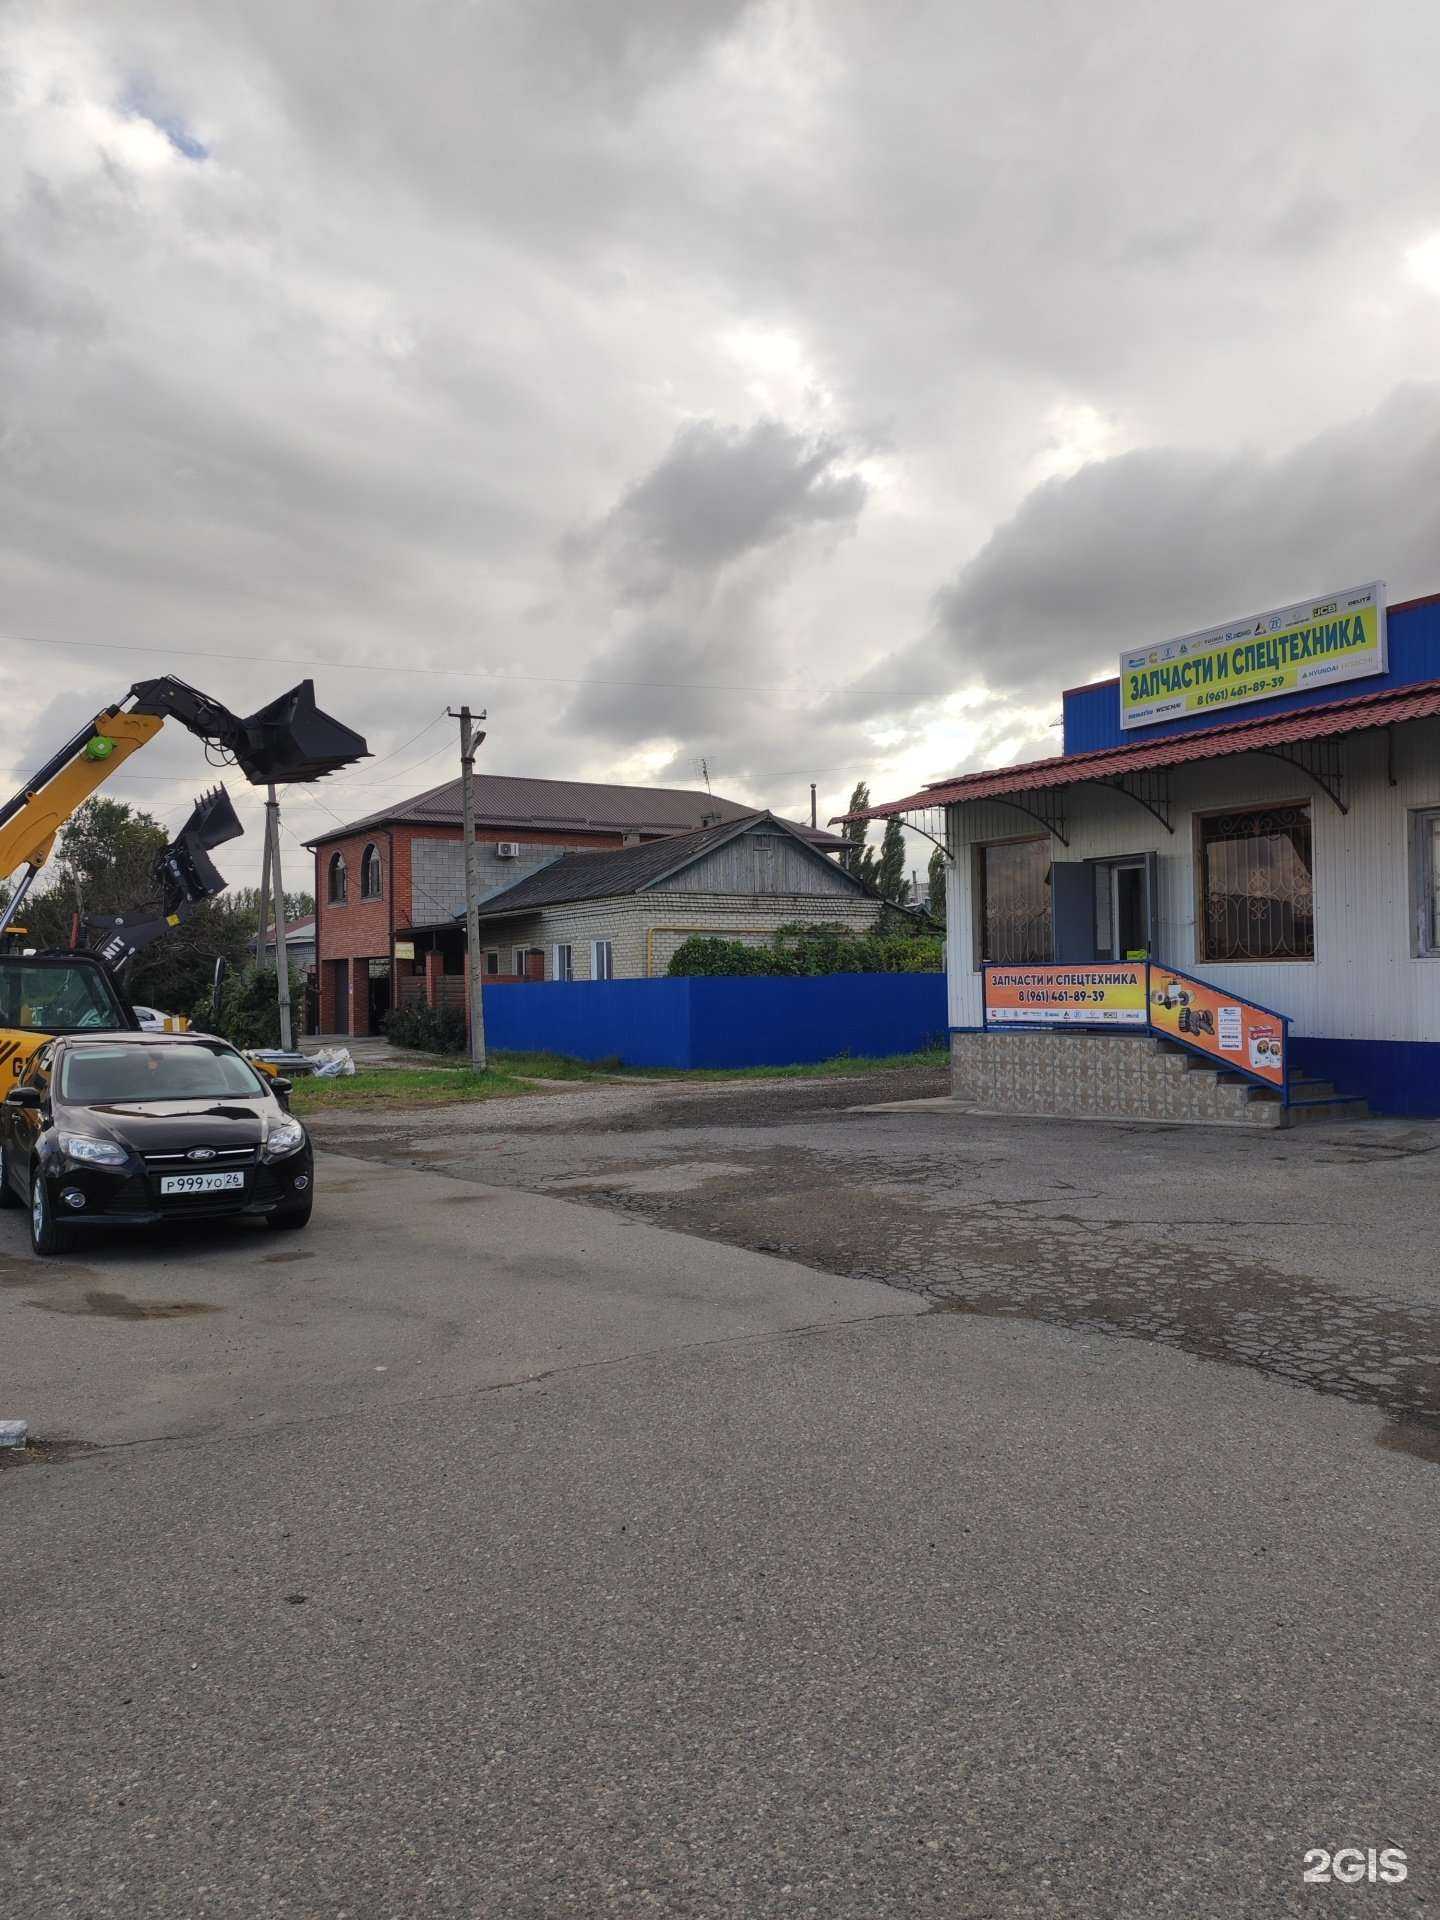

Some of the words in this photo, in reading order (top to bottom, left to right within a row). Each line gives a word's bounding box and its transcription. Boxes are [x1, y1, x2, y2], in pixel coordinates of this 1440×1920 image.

[1130, 655, 1213, 701] ЗАПЧАСТИ
[1217, 652, 1229, 679] И
[1232, 616, 1366, 675] СПЕЦТЕХНИКА
[1197, 695, 1203, 705] 8
[1206, 688, 1228, 704] (961)
[1230, 676, 1284, 697] 461-89-39
[992, 974, 1044, 986] ЗАПЧАСТИ
[1046, 974, 1053, 985] И
[1056, 973, 1138, 987] СПЕЦТЕХНИКА
[1018, 991, 1024, 1001] 8
[1027, 990, 1049, 1003] (961)
[1051, 990, 1104, 1002] 461-89-39
[226, 1174, 239, 1184] 26
